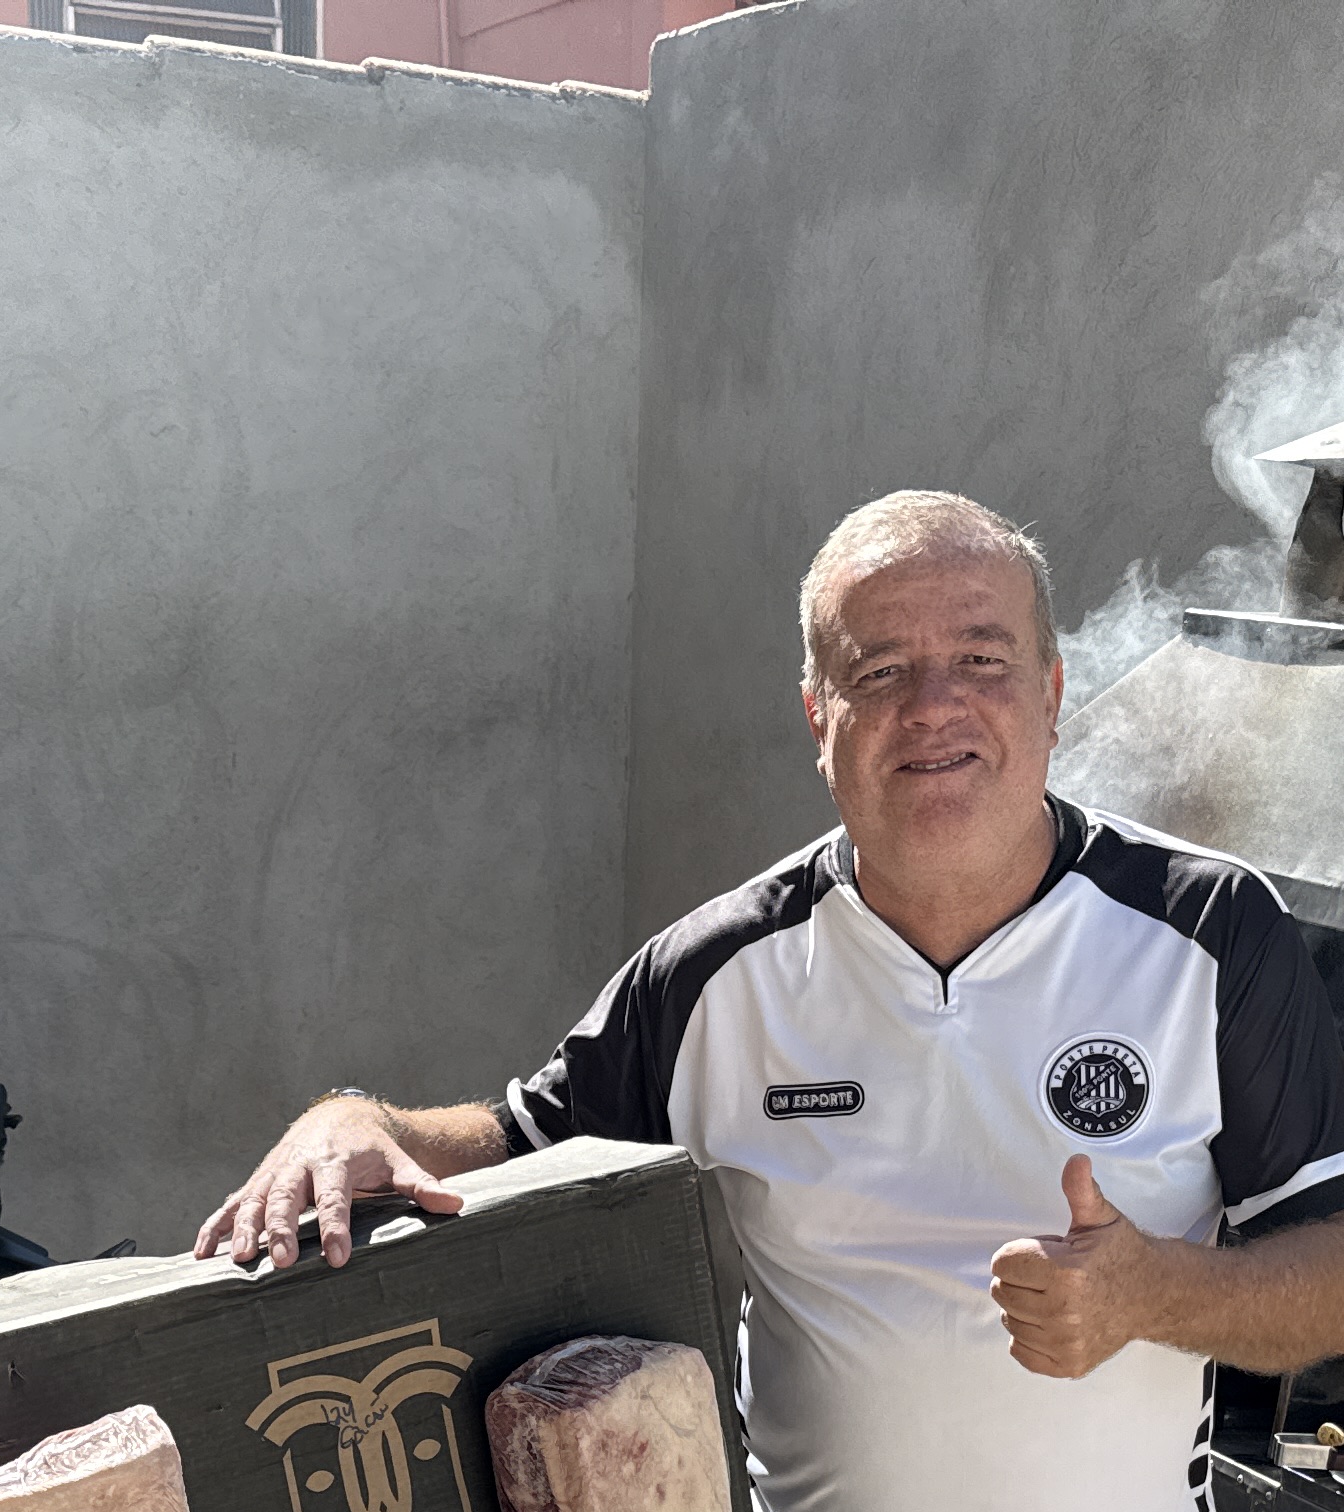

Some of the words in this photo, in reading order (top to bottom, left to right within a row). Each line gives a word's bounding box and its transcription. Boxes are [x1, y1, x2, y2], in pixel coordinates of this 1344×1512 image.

[792, 1090, 854, 1109] ESPORTE
[1062, 1109, 1105, 1132] ZONA
[1108, 1108, 1136, 1130] SUL
